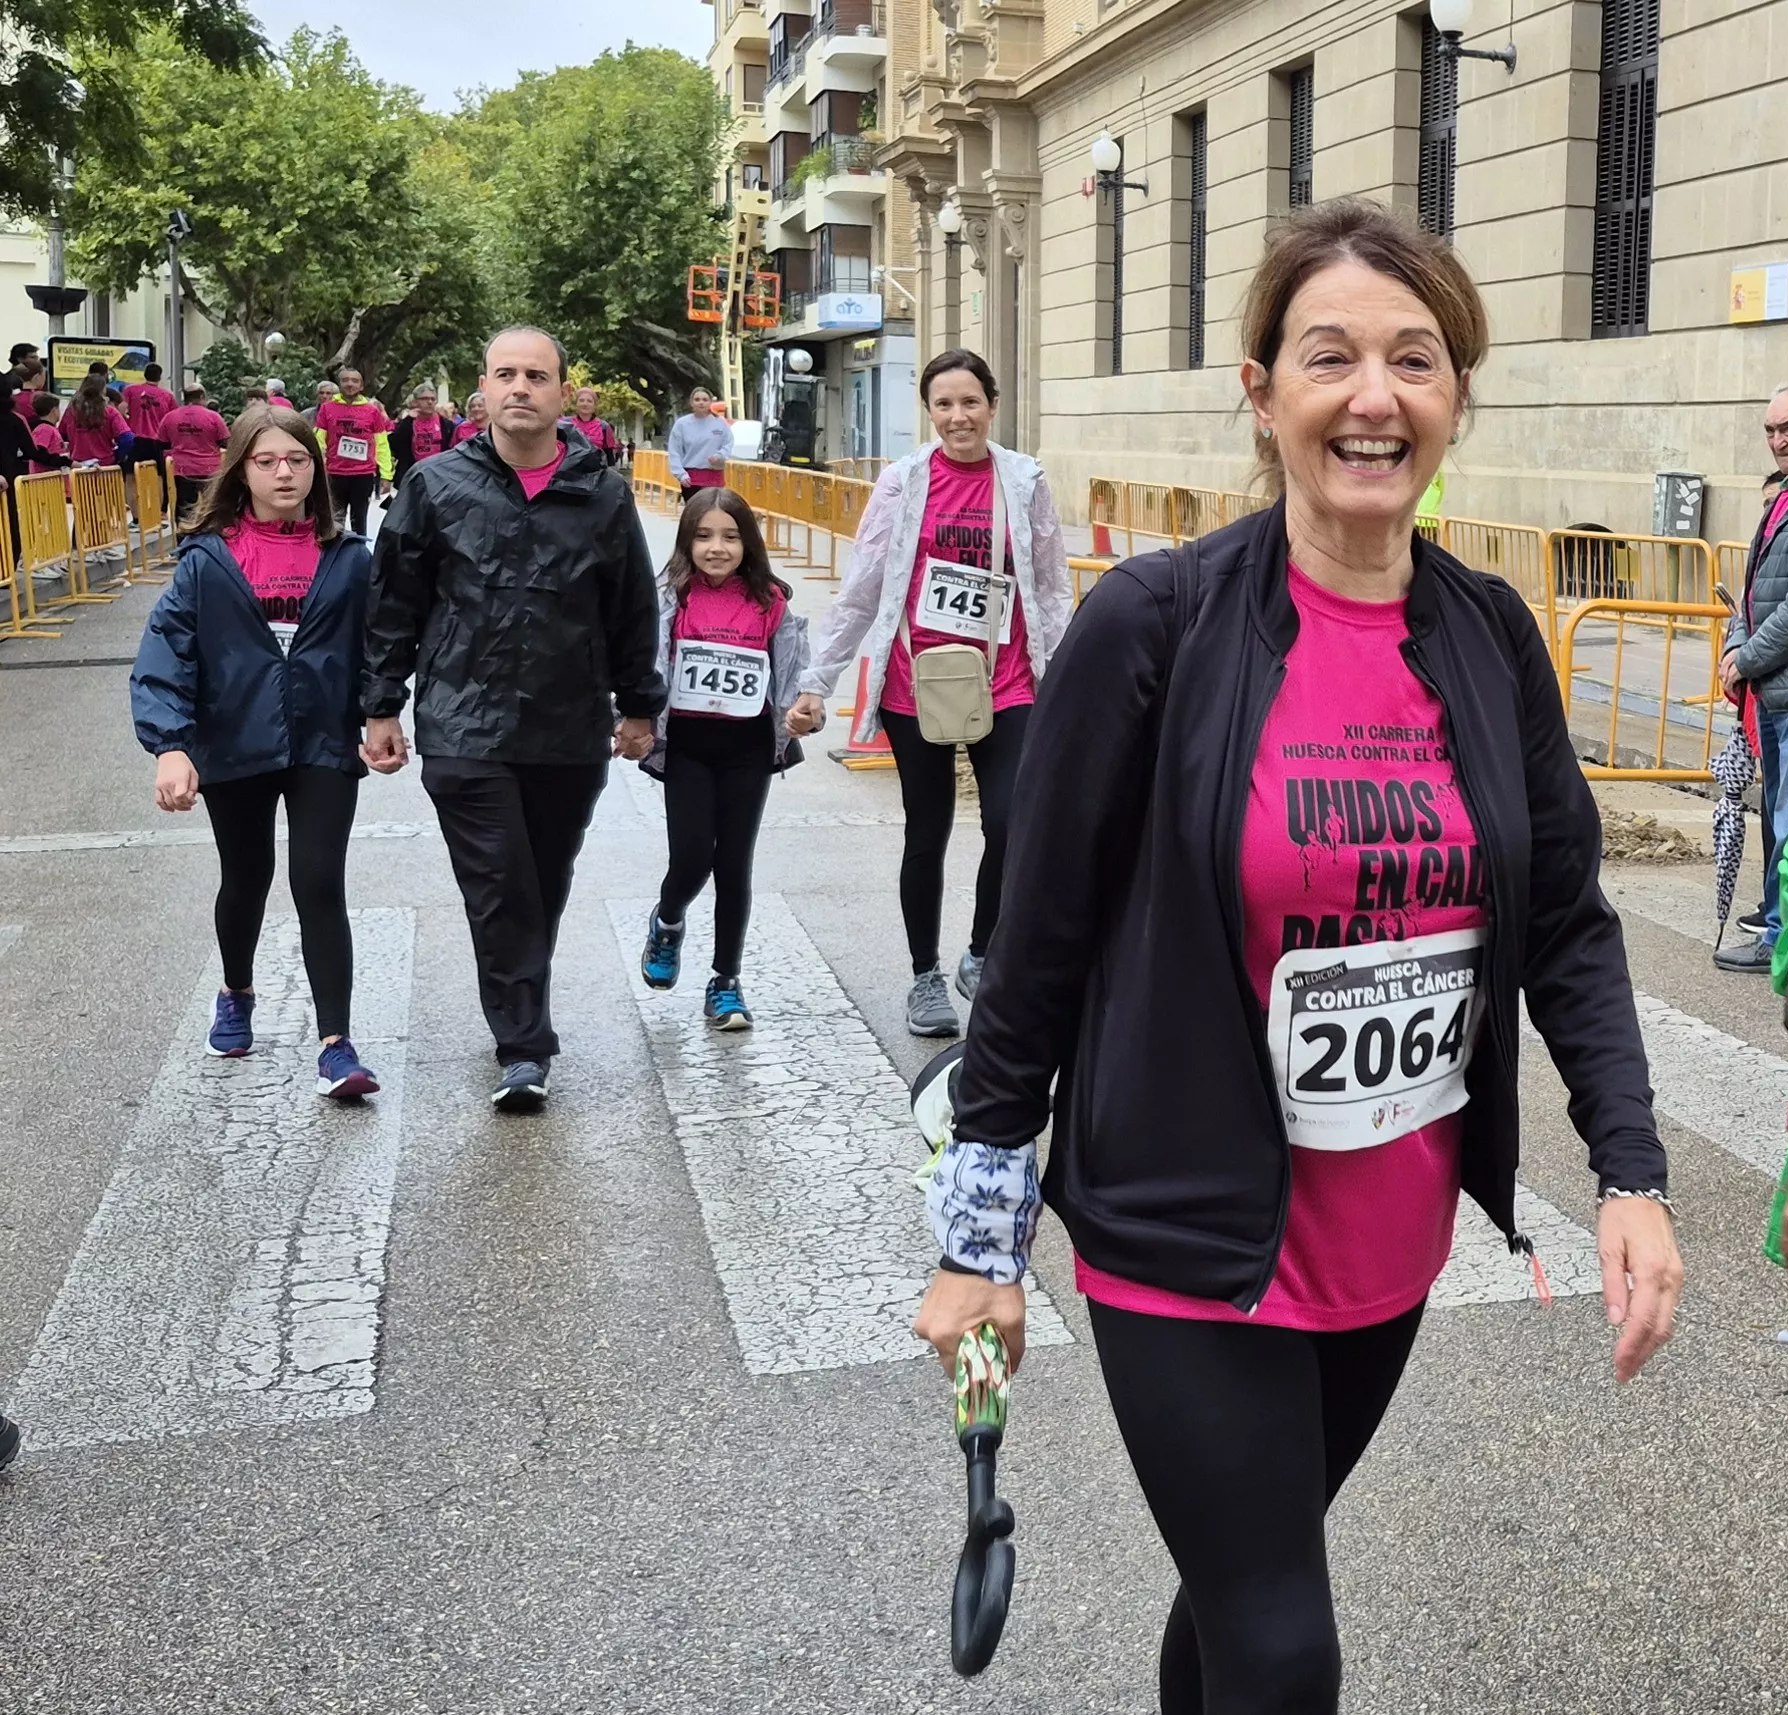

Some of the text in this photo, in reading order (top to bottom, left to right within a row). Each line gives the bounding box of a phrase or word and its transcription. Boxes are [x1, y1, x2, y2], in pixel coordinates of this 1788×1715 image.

[343, 443, 364, 454] 1753
[935, 524, 993, 550] UNIDOS
[960, 549, 978, 567] EN
[936, 574, 969, 588] CONTRA
[970, 579, 979, 589] EL
[933, 586, 1005, 618] 145
[686, 654, 721, 665] CONTRA
[721, 657, 729, 665] EL
[685, 665, 759, 697] 1458
[1342, 724, 1436, 743] XII CARRERA
[1282, 743, 1347, 760] HUESCA
[1351, 745, 1410, 762] CONTRA
[1413, 747, 1431, 762] EL
[1284, 777, 1444, 846] UNIDOS
[1354, 848, 1410, 911] EN
[1289, 964, 1345, 989] XII EDICIÓN
[1374, 961, 1422, 983] HUESCA
[1305, 968, 1475, 1010] CONTRA EL CÁNCER
[1295, 997, 1468, 1092] 2064
